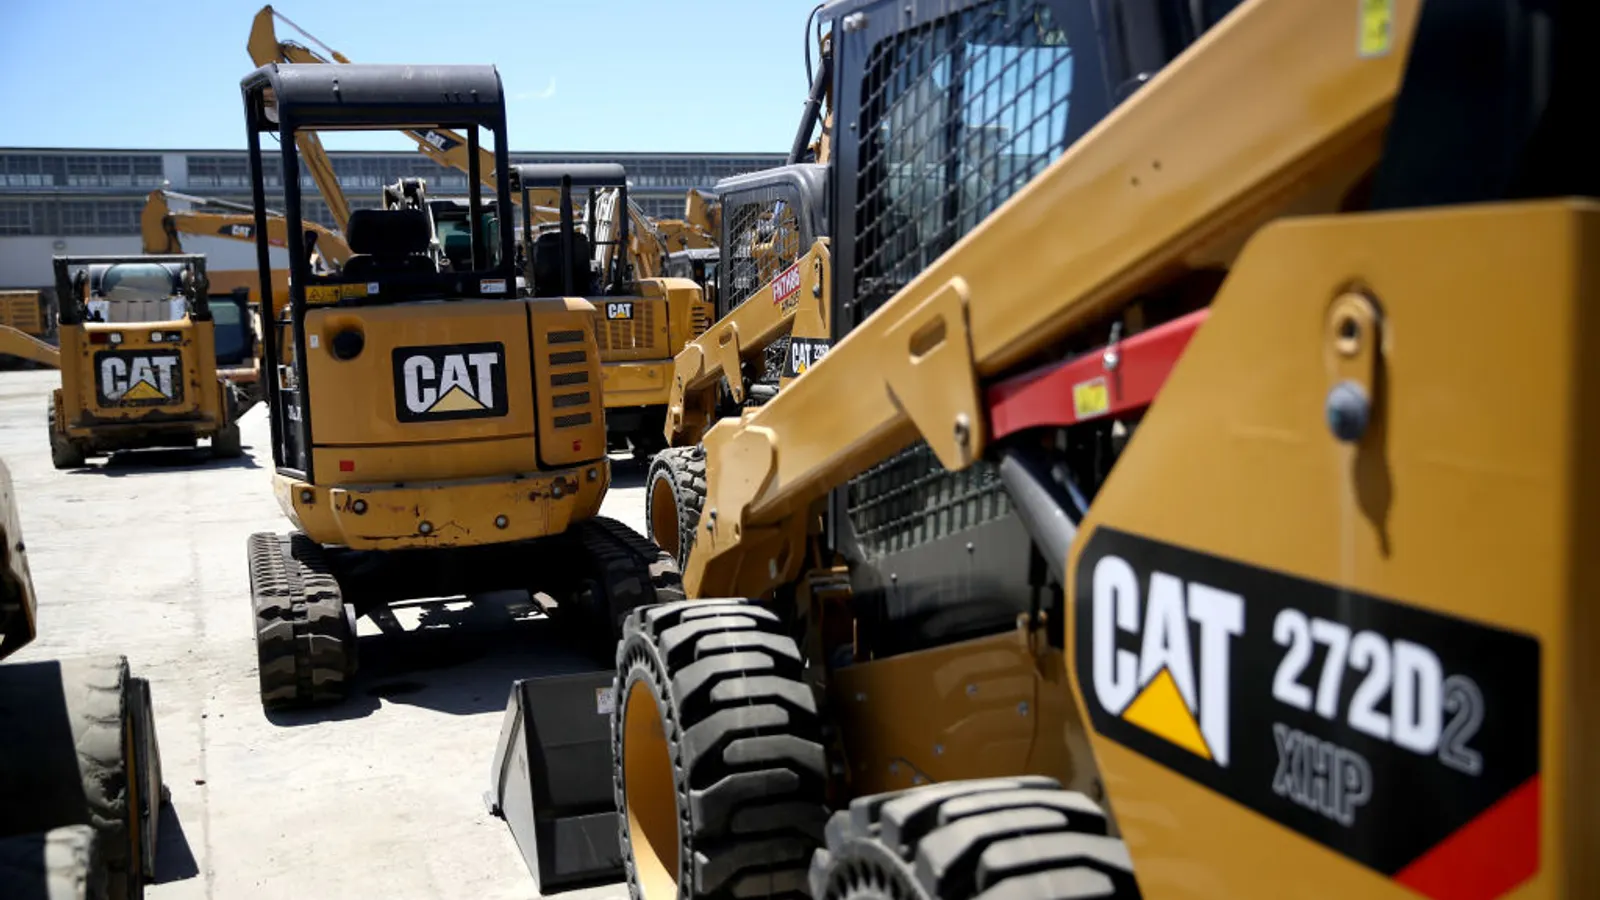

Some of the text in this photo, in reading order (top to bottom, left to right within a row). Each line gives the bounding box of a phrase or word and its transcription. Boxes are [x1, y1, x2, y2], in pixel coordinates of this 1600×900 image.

[425, 130, 447, 150] CAT
[232, 225, 251, 238] CAT
[608, 303, 632, 319] CAT
[792, 342, 812, 373] CAT
[101, 356, 178, 400] CAT
[403, 352, 498, 413] CAT
[1092, 555, 1245, 767] CAT
[1271, 721, 1373, 828] XHP
